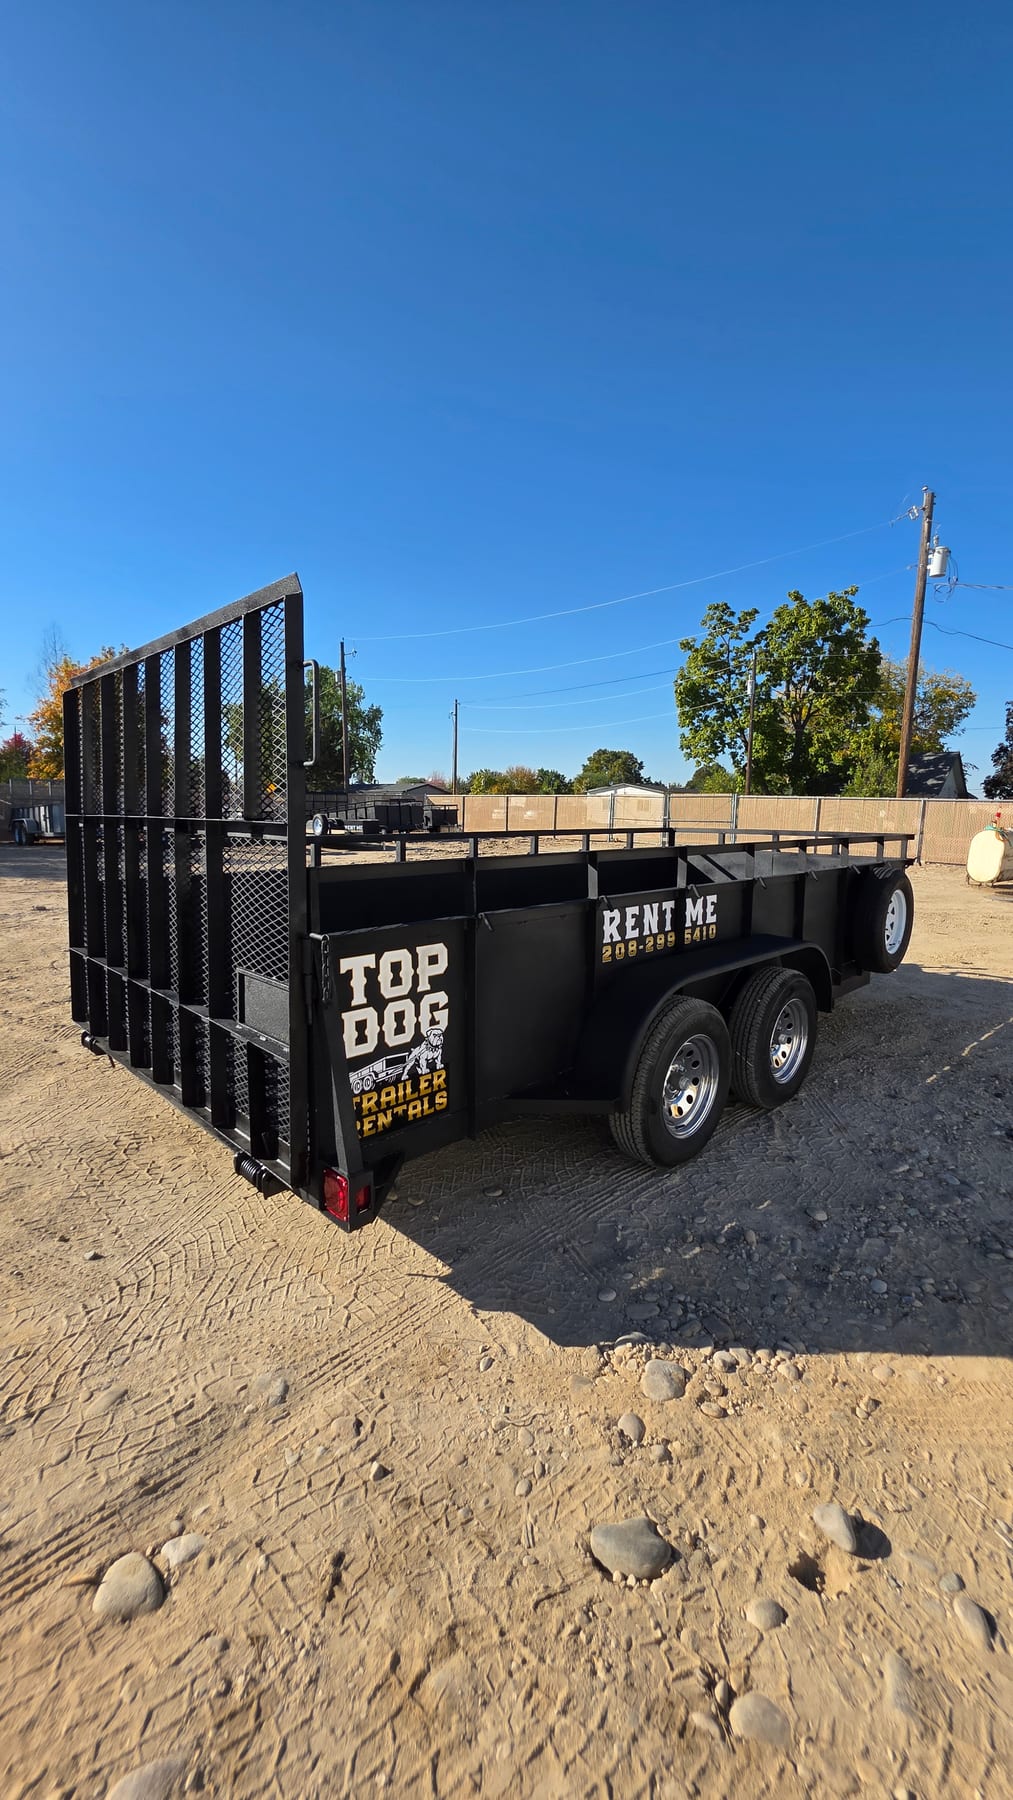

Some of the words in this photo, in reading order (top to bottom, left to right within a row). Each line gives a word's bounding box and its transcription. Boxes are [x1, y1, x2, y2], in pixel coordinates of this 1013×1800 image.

[602, 930, 676, 963] 208-299
[684, 924, 717, 945] 5410
[603, 900, 675, 944] RENT
[685, 894, 717, 927] ME
[339, 942, 448, 1006] TOP
[341, 990, 448, 1059] DOG
